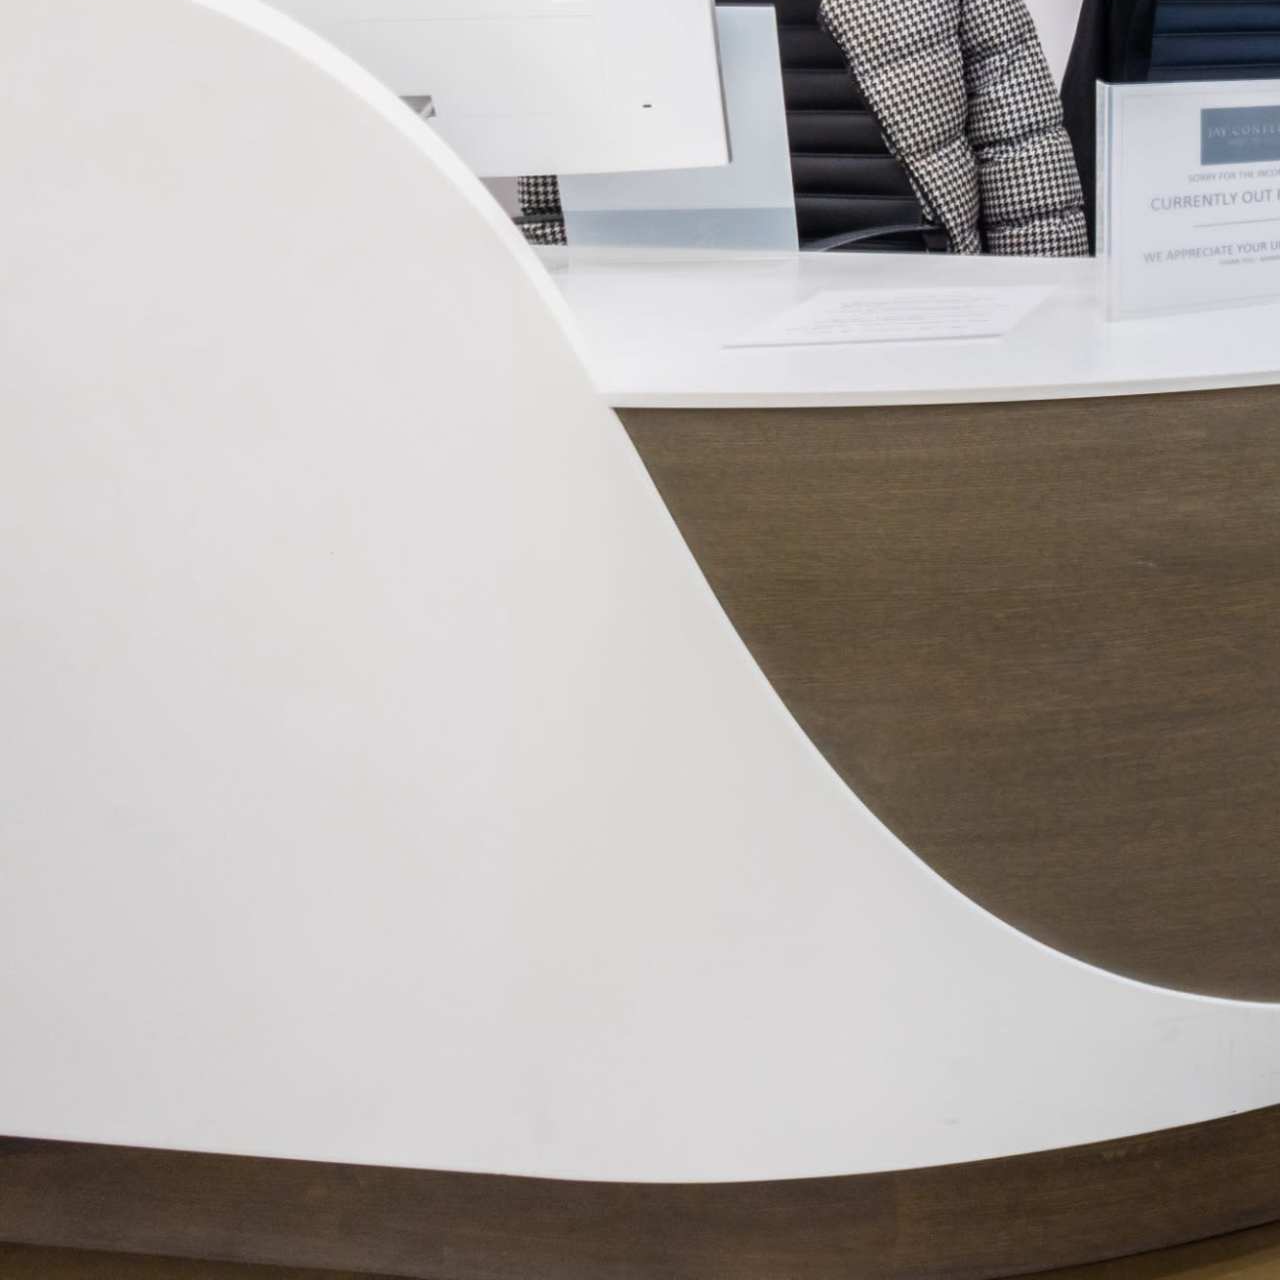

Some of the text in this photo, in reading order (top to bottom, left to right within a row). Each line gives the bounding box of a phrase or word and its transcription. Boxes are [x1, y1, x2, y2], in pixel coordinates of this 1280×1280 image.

[1219, 172, 1237, 182] FOR
[1150, 191, 1239, 211] CURRENTLY
[1241, 188, 1273, 205] OUT
[1143, 250, 1162, 264] WE
[1165, 245, 1234, 261] APPRECIATE
[1237, 241, 1268, 255] YOUR
